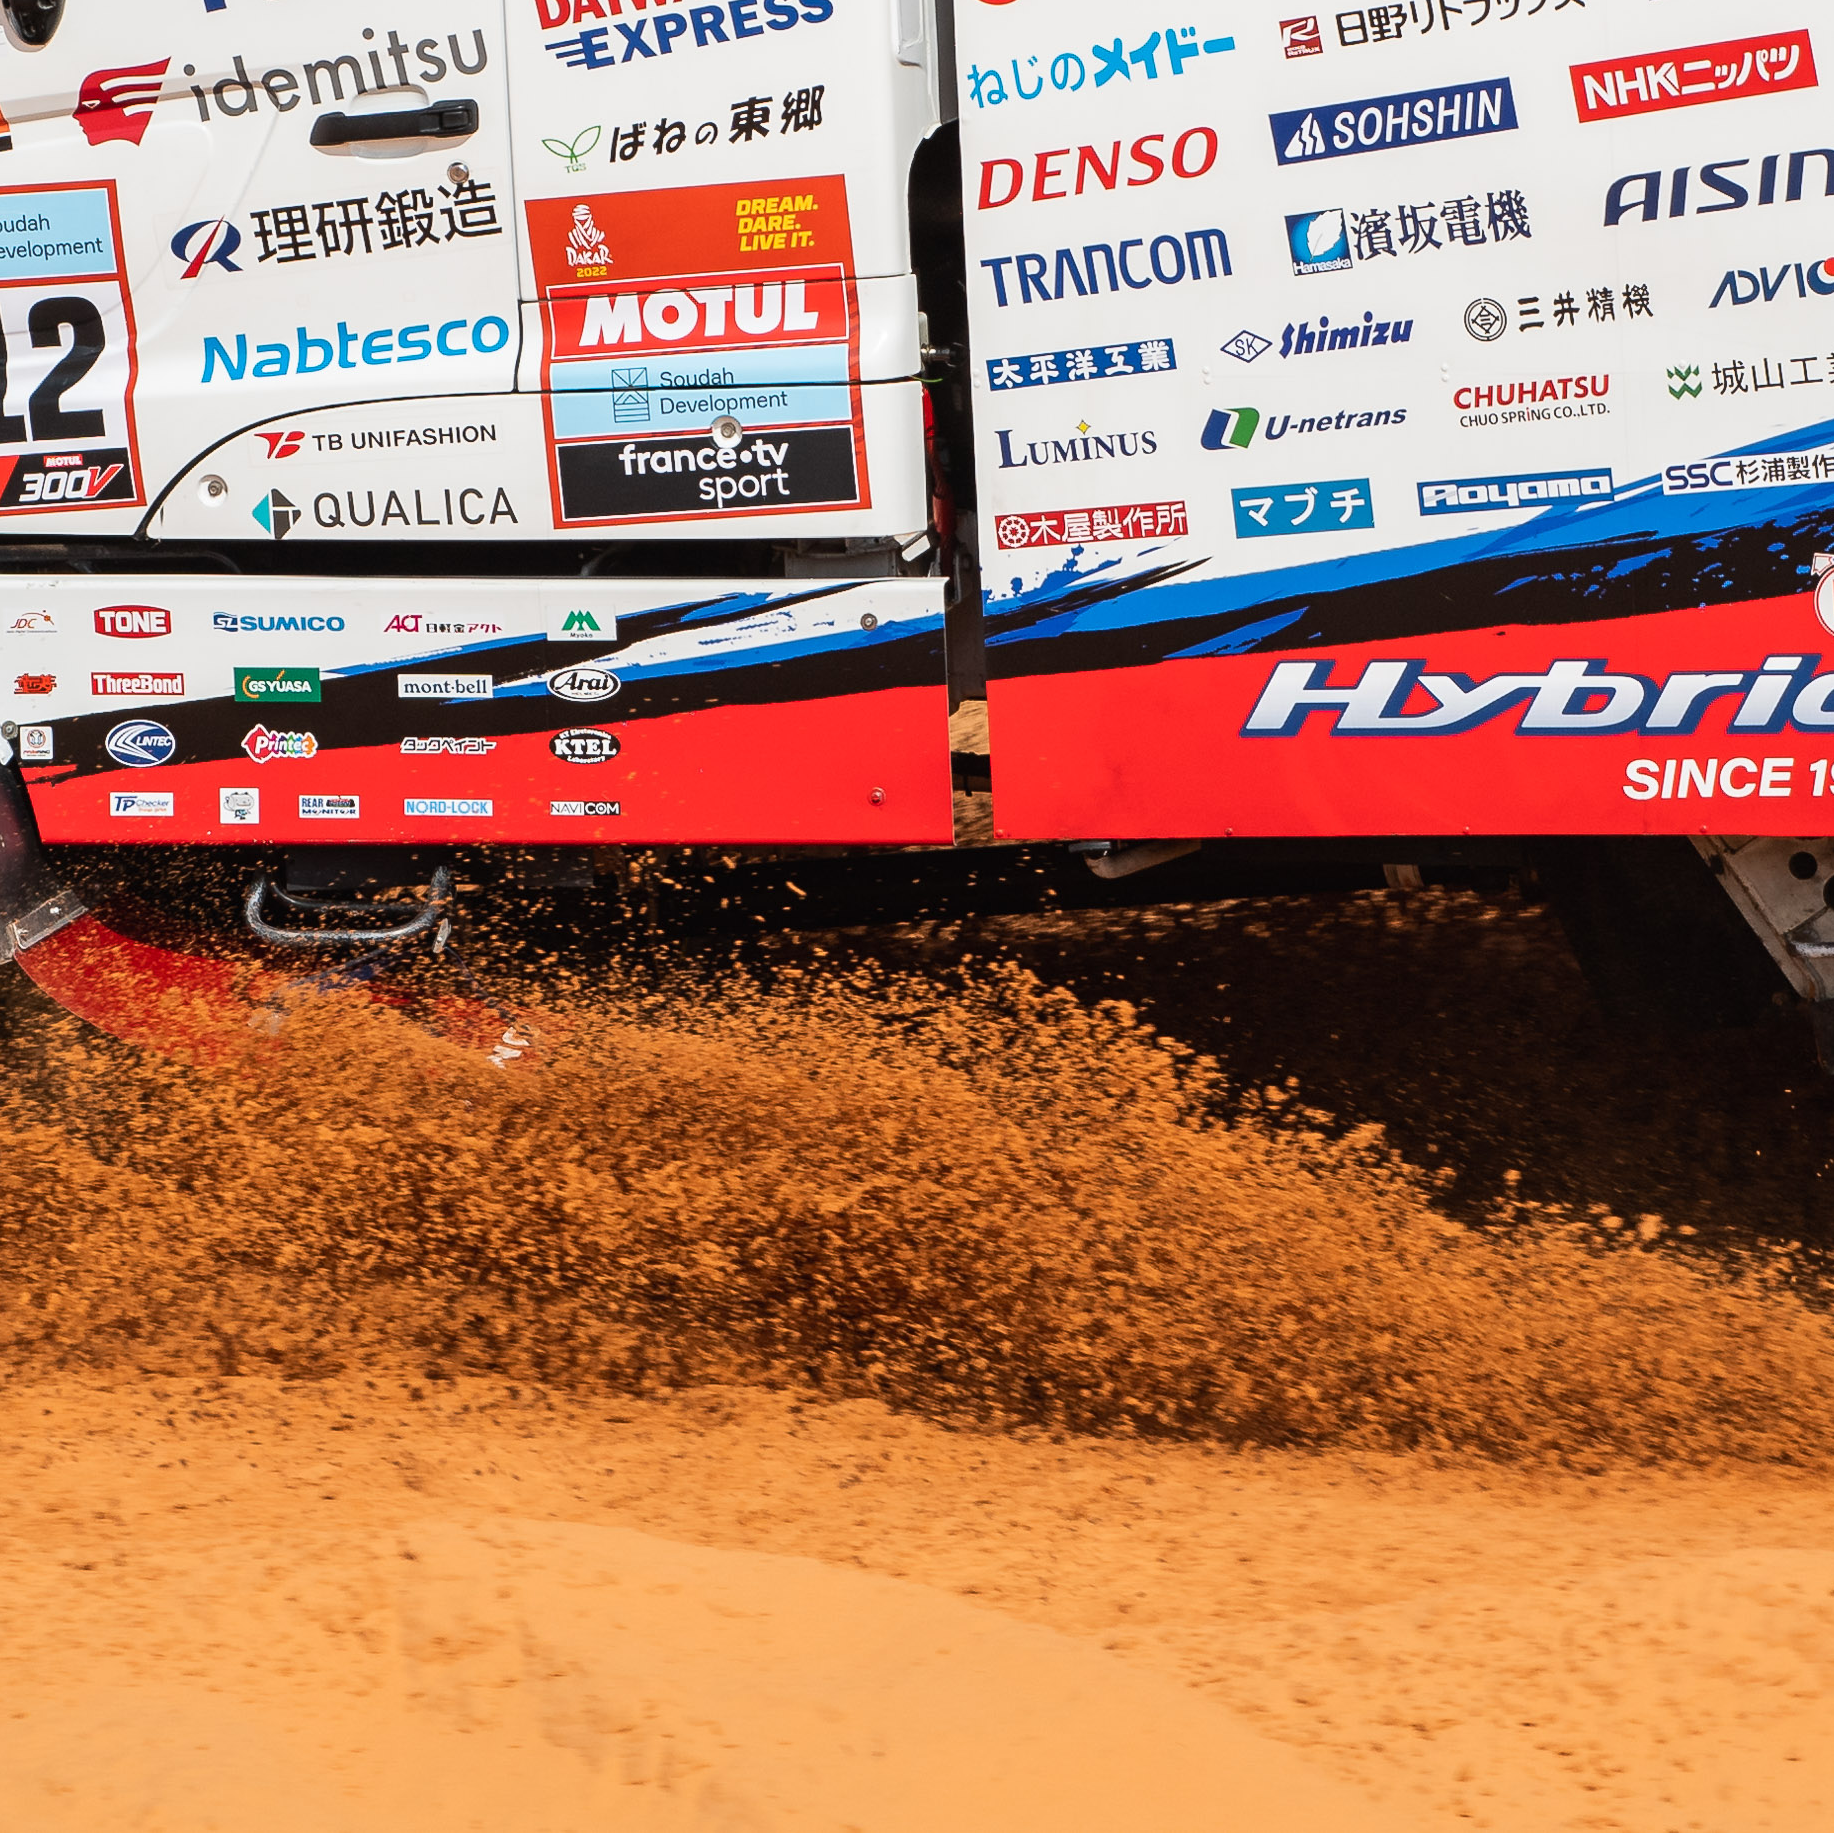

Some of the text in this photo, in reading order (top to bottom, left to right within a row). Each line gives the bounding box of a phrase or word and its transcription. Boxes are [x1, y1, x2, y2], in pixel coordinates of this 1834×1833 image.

[182, 26, 489, 124] idemitsu
[966, 24, 1236, 110] ねじのメイドー
[1582, 42, 1801, 111] NHKニッパツ
[608, 83, 827, 165] ばねの東郷
[1332, 87, 1504, 151] SOHSHIN
[976, 125, 1220, 212] DENSO
[735, 193, 819, 217] DREAM.
[249, 177, 504, 265] 理研鍛造
[737, 213, 802, 235] DARE.
[1350, 188, 1534, 263] 濱坂電機
[565, 243, 614, 267] DAKAR
[739, 230, 816, 253] LIVE IT.
[576, 266, 608, 278] 2022
[1292, 254, 1353, 276] Hamasaka
[578, 278, 820, 348] MOTUL
[1516, 282, 1655, 334] 三井精機
[200, 314, 510, 384] Nabtesco
[1279, 310, 1414, 360] Shimizu
[659, 367, 735, 388] Soudah
[991, 339, 1171, 390] 太平洋工業
[660, 390, 789, 415] Development
[1452, 373, 1610, 410] CHUHATSU
[311, 423, 498, 452] TB UNIFASHION
[1264, 406, 1408, 442] U-netrans
[44, 454, 84, 467] MOTUL
[1664, 459, 1734, 491] SSC
[18, 463, 124, 504] 300V
[698, 468, 791, 510] sport
[312, 486, 519, 529] QUALICA
[1238, 485, 1367, 528] マブチ
[1029, 501, 1187, 546] 木屋製作所
[9, 618, 38, 629] JDC
[98, 610, 167, 634] TONE
[239, 614, 345, 632] SUMICO
[383, 614, 424, 633] ACT
[92, 673, 183, 695] ThreeBond
[554, 672, 610, 692] Arai
[135, 736, 173, 748] LINTEC
[254, 735, 310, 754] Printec
[401, 737, 497, 754] タックペイント
[553, 739, 617, 756] KTEL
[1622, 756, 1794, 801] SINCE
[301, 797, 324, 808] REAR
[406, 800, 488, 815] NORD-LOCK
